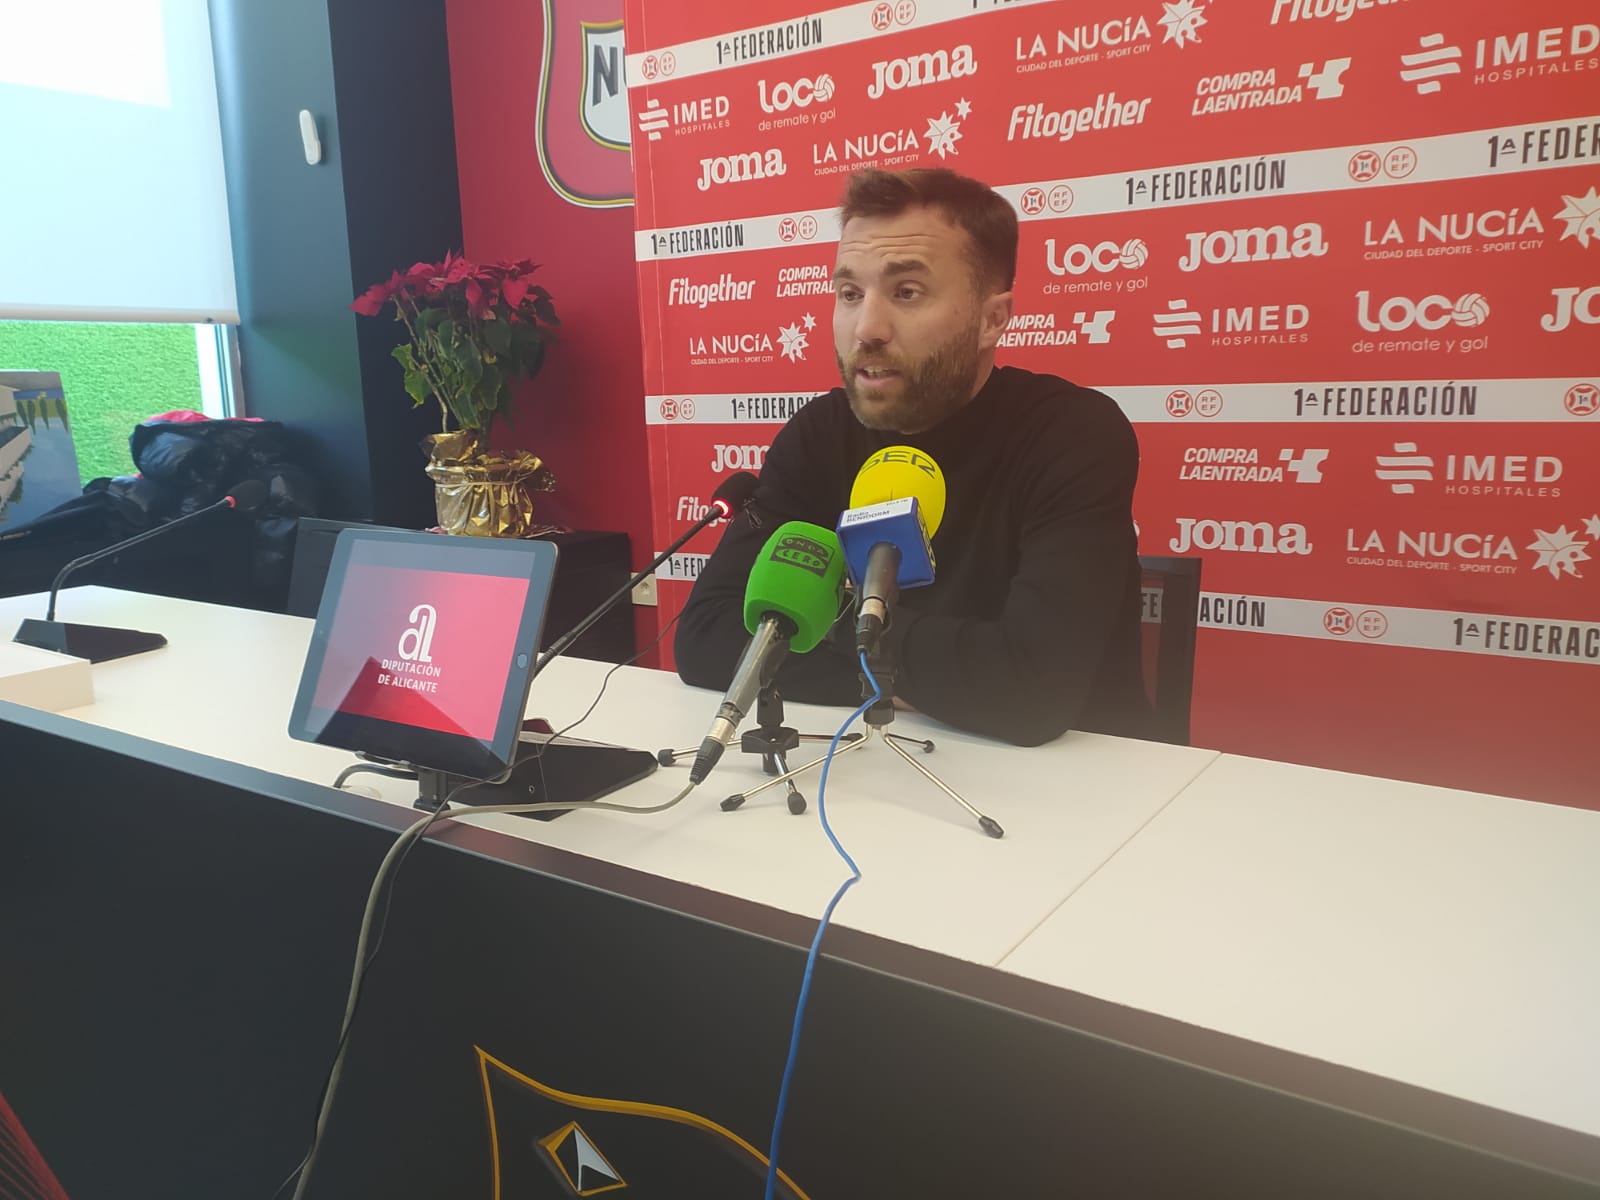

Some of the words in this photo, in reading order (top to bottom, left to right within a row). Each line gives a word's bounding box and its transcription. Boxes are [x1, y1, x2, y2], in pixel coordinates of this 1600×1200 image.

[734, 17, 823, 61] FEDERACIÓN
[1016, 34, 1047, 61] LA
[1475, 24, 1600, 69] IMED
[867, 44, 977, 99] Joma
[1016, 62, 1047, 73] CIUDAD
[1049, 58, 1063, 68] DEL
[1065, 54, 1099, 67] DEPORTE
[1106, 46, 1132, 59] SPORT
[1133, 43, 1151, 55] CITY
[1474, 58, 1599, 85] HOSPITALES
[1196, 68, 1276, 96] COMPRA
[673, 96, 730, 125] IMED
[1191, 85, 1302, 116] LAENTRADA
[675, 119, 730, 136] HOSPITALES
[758, 118, 772, 131] de
[773, 113, 810, 129] remate
[811, 113, 818, 126] y
[819, 108, 836, 123] gol
[1007, 92, 1152, 142] Fitogether
[813, 141, 838, 164] LA
[697, 148, 787, 191] Joma
[1151, 156, 1286, 203] FEDERACIÓN
[670, 221, 744, 254] FEDERACIÓN
[1364, 219, 1403, 246] LA
[1178, 222, 1328, 272] Joma
[1364, 249, 1403, 260] CIUDAD
[1406, 248, 1424, 258] DEL
[1427, 245, 1472, 257] DEPORTE
[1483, 242, 1516, 253] SPORT
[1519, 239, 1544, 250] CITY
[778, 265, 828, 282] COMPRA
[1043, 280, 1061, 294] de
[1064, 277, 1112, 293] remate
[1115, 280, 1124, 293] y
[1127, 276, 1148, 296] gol
[668, 273, 755, 309] Fitogether
[776, 280, 836, 298] LAENTRAD
[1212, 304, 1310, 333] IMED
[689, 337, 707, 355] LA
[995, 330, 1077, 347] AENTRADA
[1211, 334, 1309, 346] HOSPITALES
[1352, 339, 1375, 353] de
[1378, 337, 1440, 352] remate
[1445, 340, 1453, 354] y
[1460, 336, 1488, 354] gol
[1322, 381, 1477, 416] FEDERACIÓN
[711, 444, 771, 473] Jom
[1183, 447, 1258, 463] COMPRA
[1179, 465, 1283, 482] LAENTRADA
[1446, 455, 1563, 483] IMED
[1445, 485, 1562, 498] HOSPITALES
[1169, 518, 1313, 555] Joma
[1347, 528, 1385, 553] LA
[1347, 557, 1385, 567] CIUDAD
[1387, 559, 1404, 568] DEL
[1407, 560, 1449, 571] DEPORTE
[1460, 563, 1491, 573] SPORT
[1494, 565, 1518, 574] CITY
[381, 659, 441, 677] DIPUTACIÓN
[377, 674, 391, 685] DE
[392, 676, 438, 693] ALICANTE
